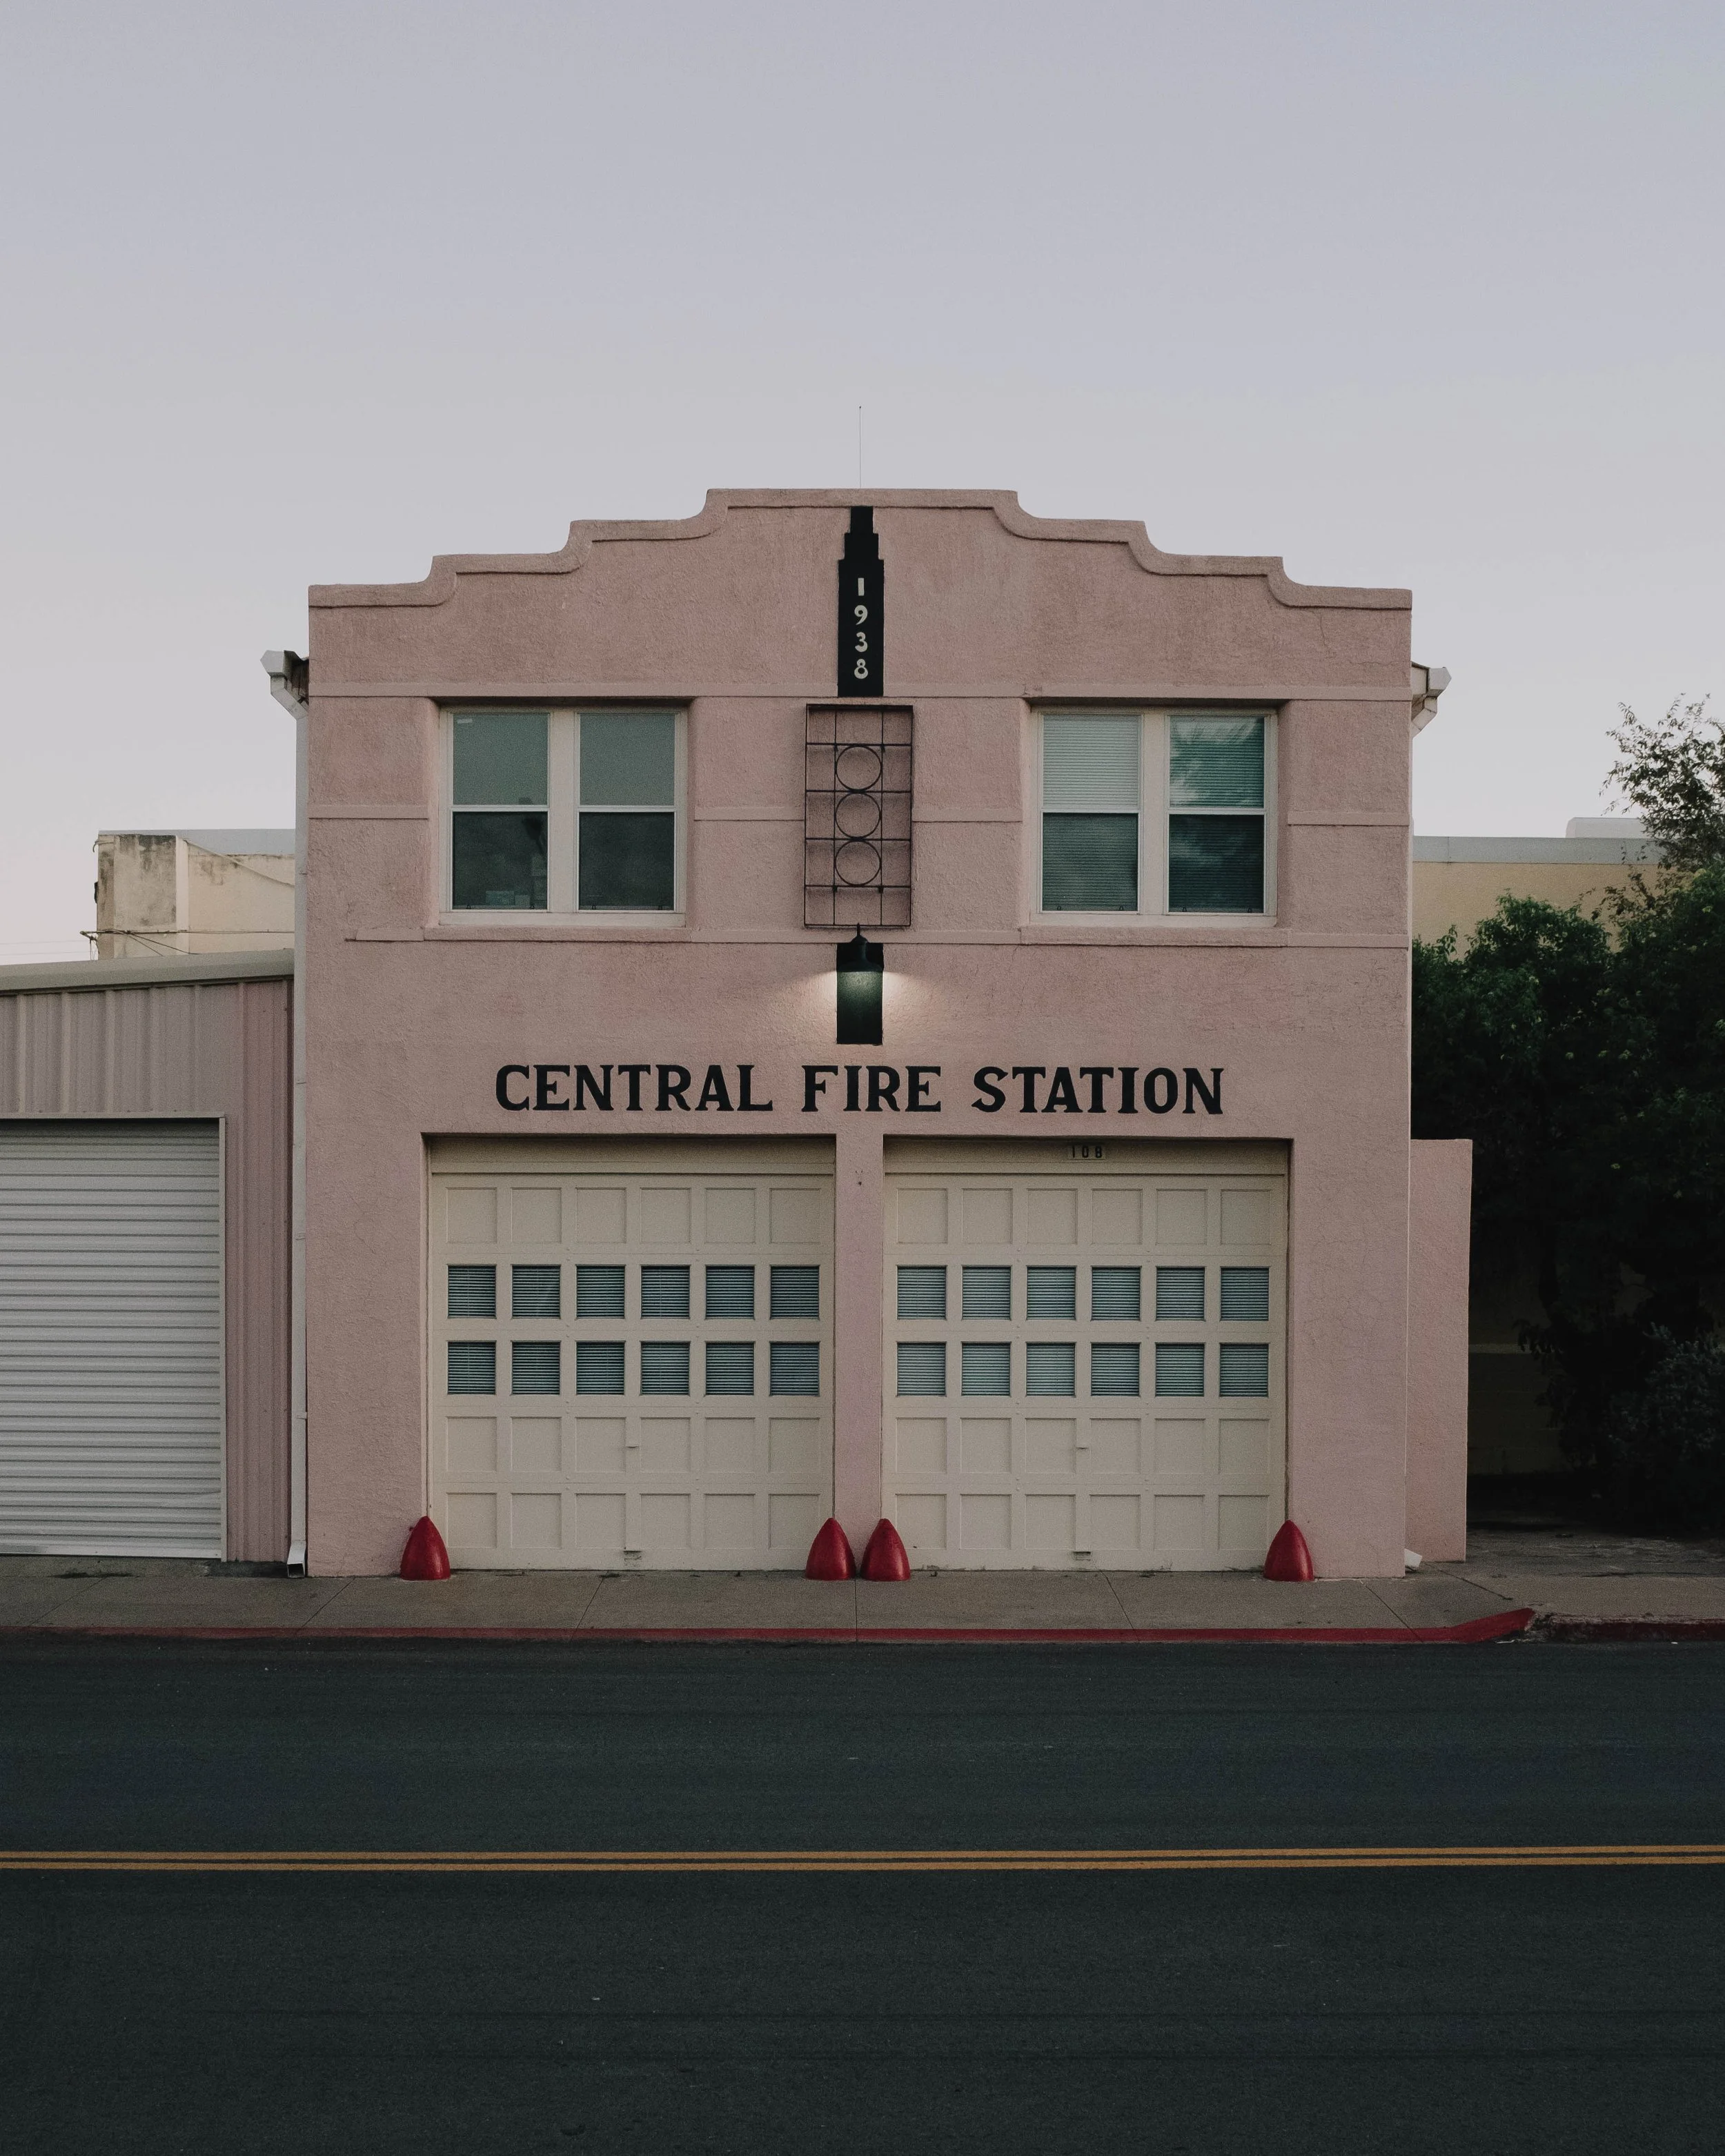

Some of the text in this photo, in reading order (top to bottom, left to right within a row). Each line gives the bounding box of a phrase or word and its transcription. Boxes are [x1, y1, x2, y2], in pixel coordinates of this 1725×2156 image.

[854, 577, 869, 680] 1938
[495, 1064, 1225, 1115] CENTRAL FIRE STATION
[1072, 1145, 1102, 1158] 108
